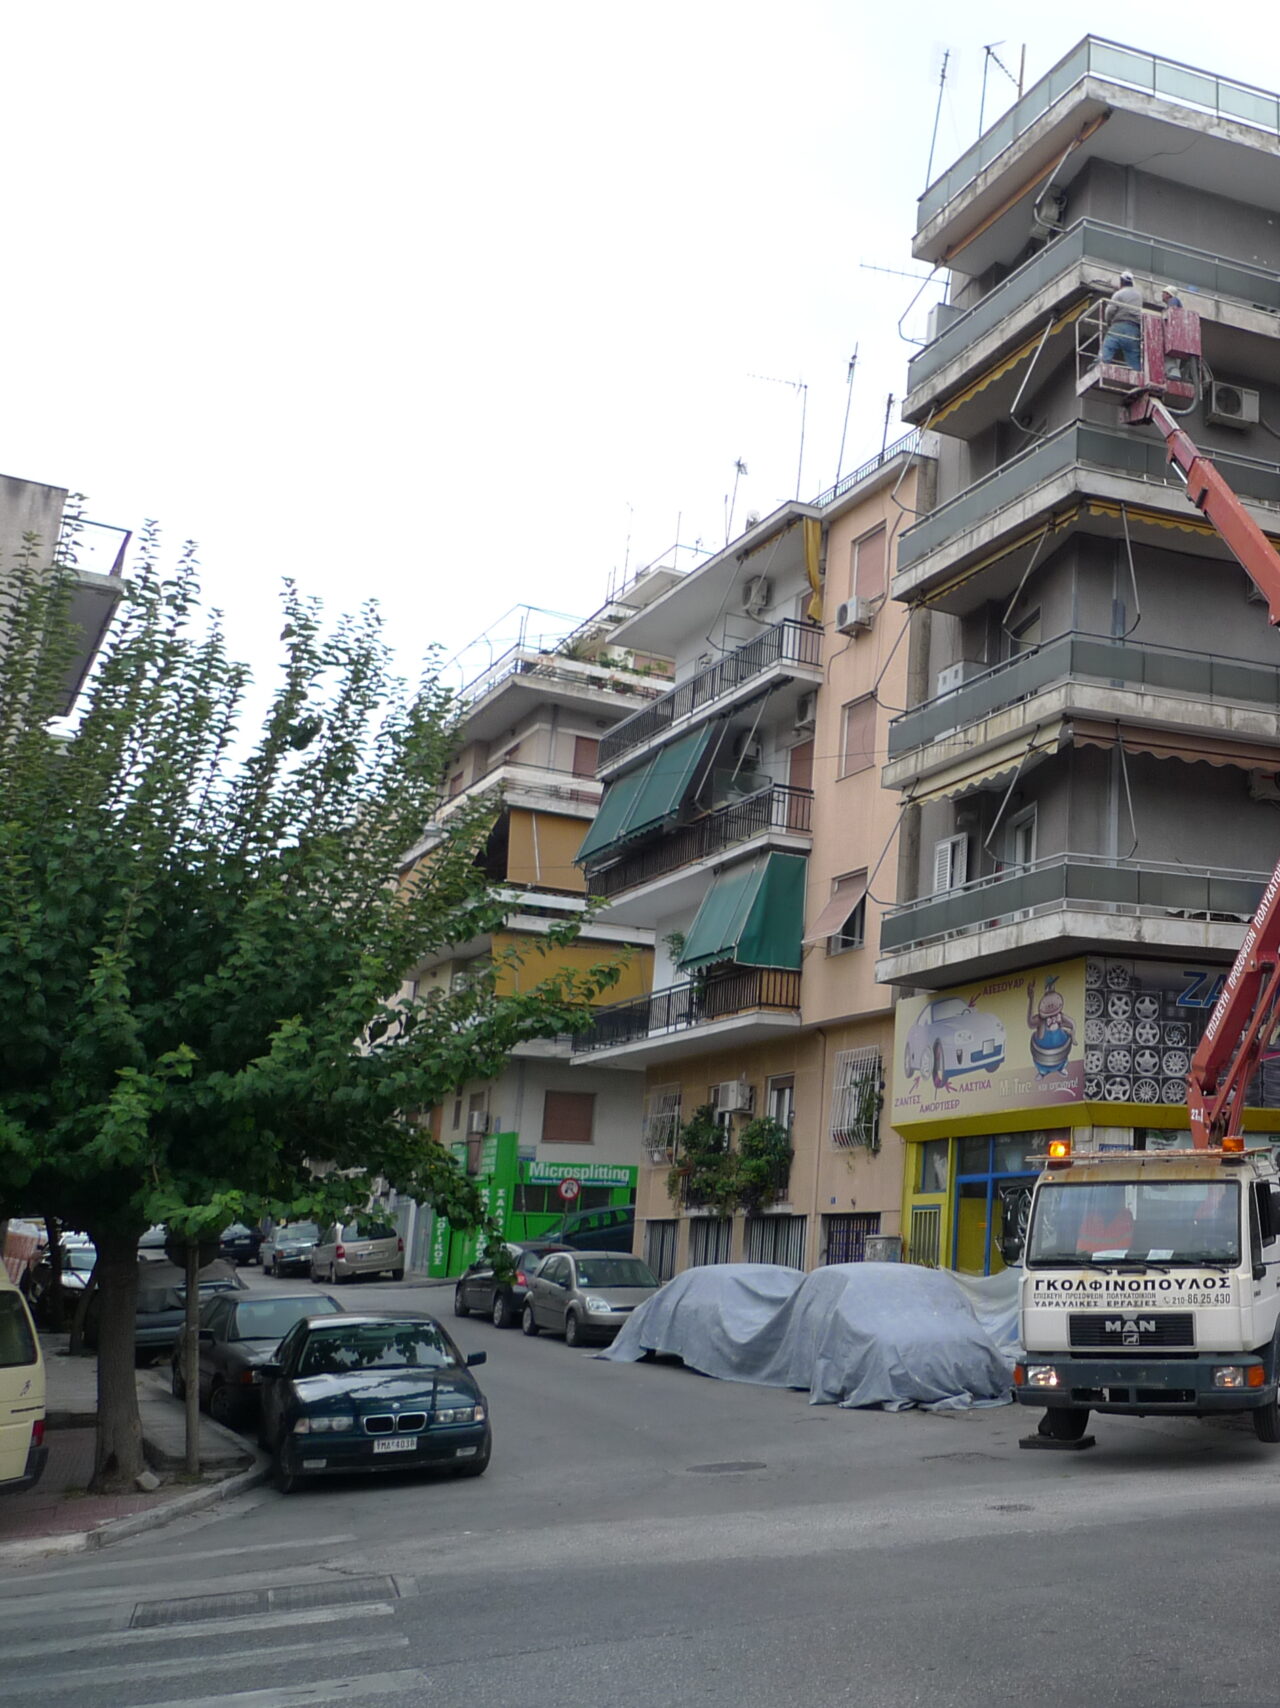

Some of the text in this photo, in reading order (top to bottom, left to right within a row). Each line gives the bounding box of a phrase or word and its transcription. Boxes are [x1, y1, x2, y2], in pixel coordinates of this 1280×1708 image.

[958, 1080, 992, 1093] ΛΑΣΤΙΧΑ
[529, 1162, 630, 1181] Microsplitting
[1034, 1277, 1231, 1292] ΓΚΟΛΦΙΝΟΠΟΥΛΟΣ
[1105, 1320, 1156, 1332] MAN
